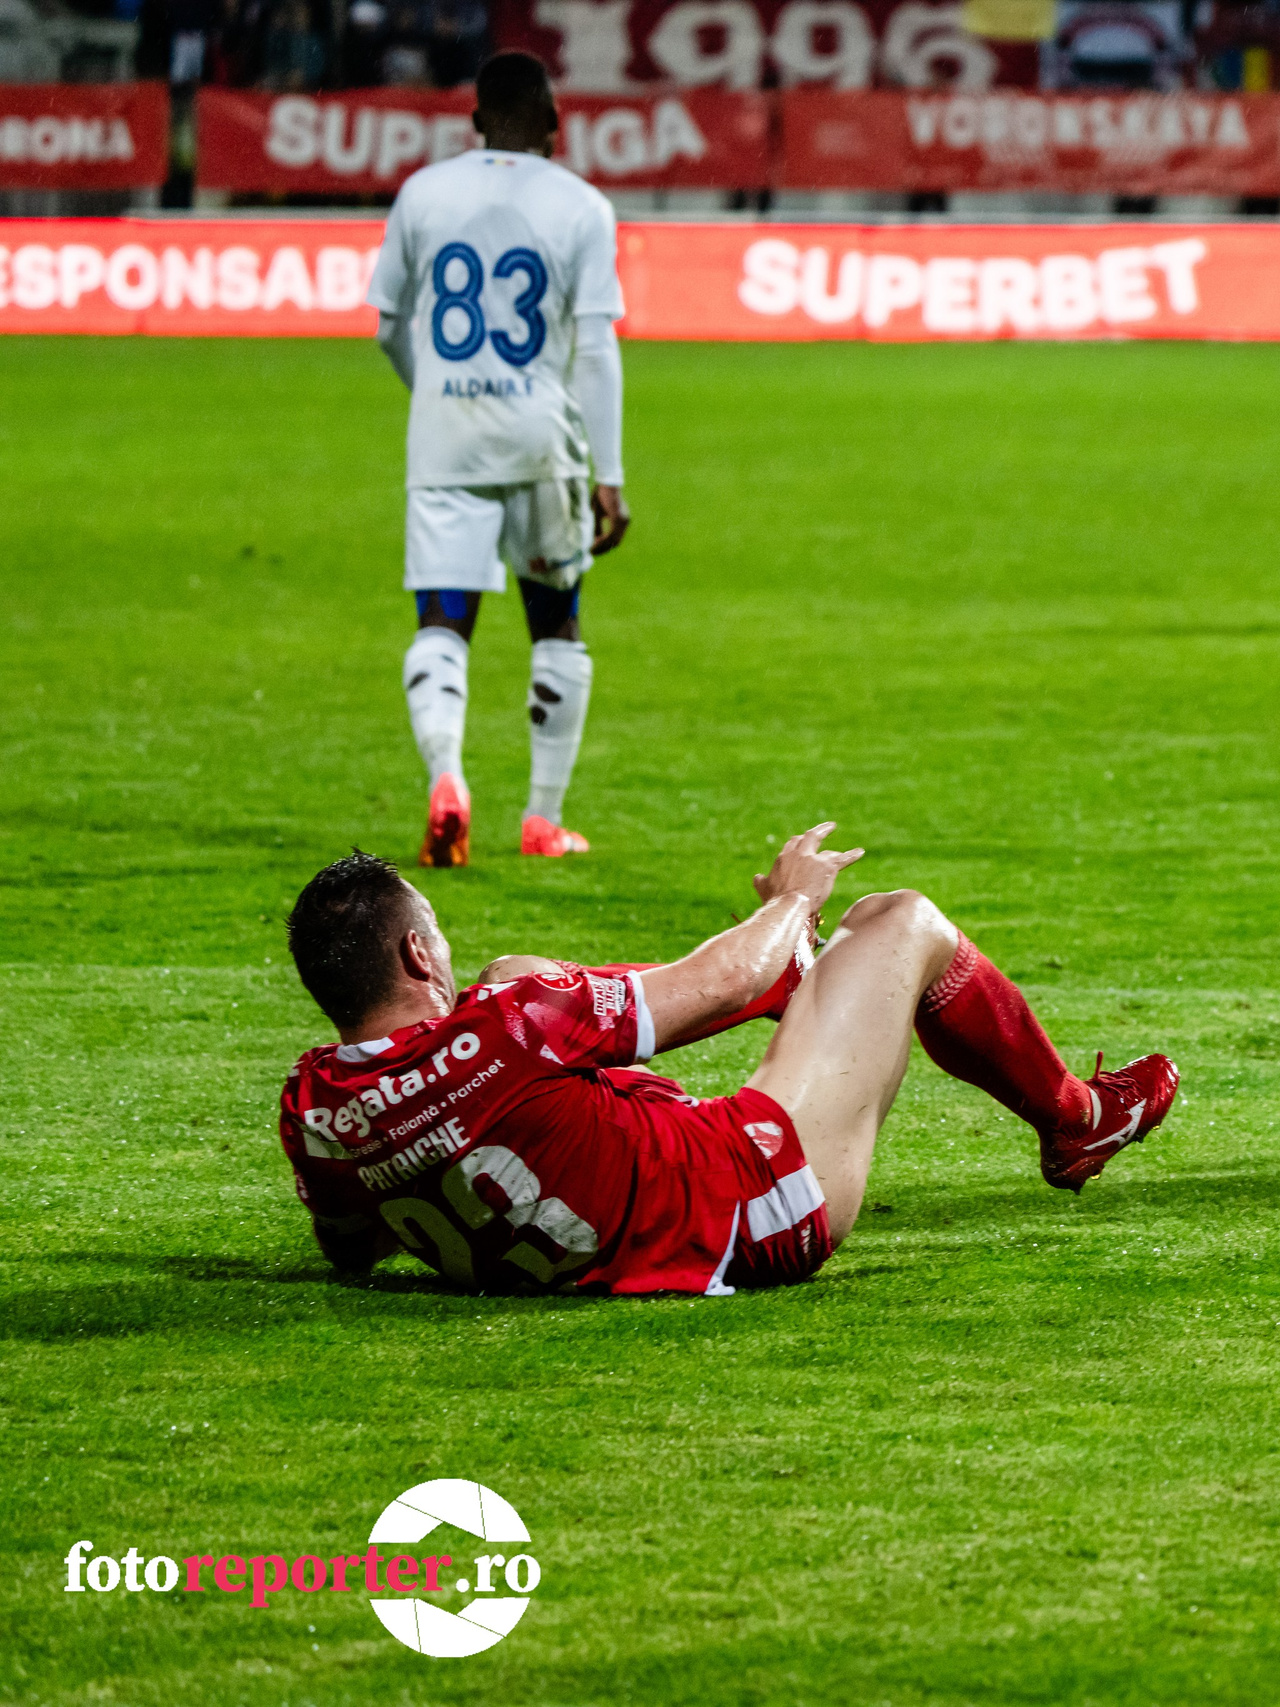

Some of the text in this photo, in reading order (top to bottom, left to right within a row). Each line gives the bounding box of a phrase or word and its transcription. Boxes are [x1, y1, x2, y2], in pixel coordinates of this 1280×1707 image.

[267, 99, 706, 178] SUPEIGA
[0, 244, 383, 311] SPONSAB
[432, 241, 548, 367] 83
[738, 238, 1206, 331] SUPERBET
[304, 1032, 481, 1141] Regata.ro
[388, 1104, 440, 1140] Faianță
[447, 1058, 506, 1104] Parchet
